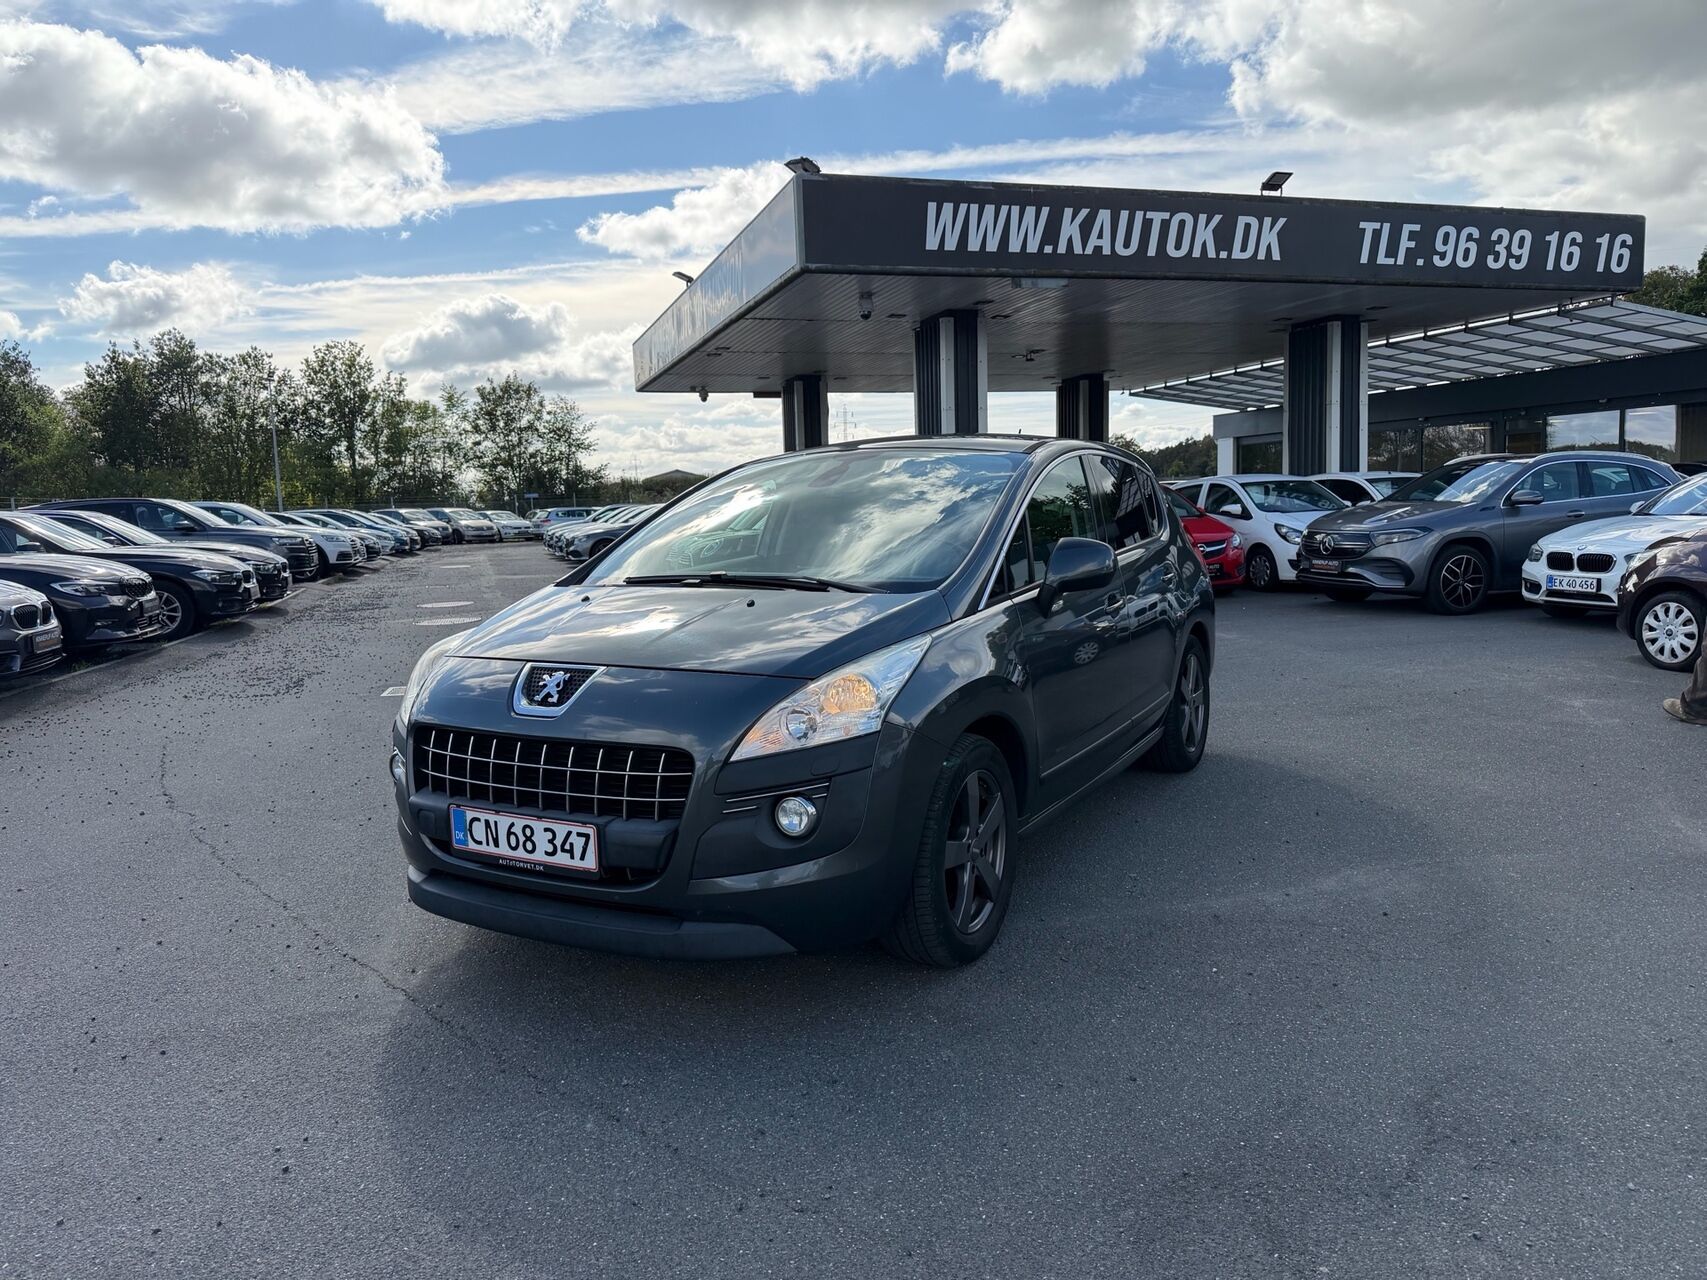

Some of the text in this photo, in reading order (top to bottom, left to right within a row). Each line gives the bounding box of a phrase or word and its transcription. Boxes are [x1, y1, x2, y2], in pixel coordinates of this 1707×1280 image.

[925, 201, 1288, 261] WWW.KAUTOK.DK
[1358, 221, 1633, 274] TLF. 96 39 16 16
[1553, 578, 1564, 588] EK
[1566, 579, 1577, 589] 40
[1579, 580, 1595, 590] 456
[455, 830, 465, 841] DK
[468, 816, 591, 862] CN 68 347
